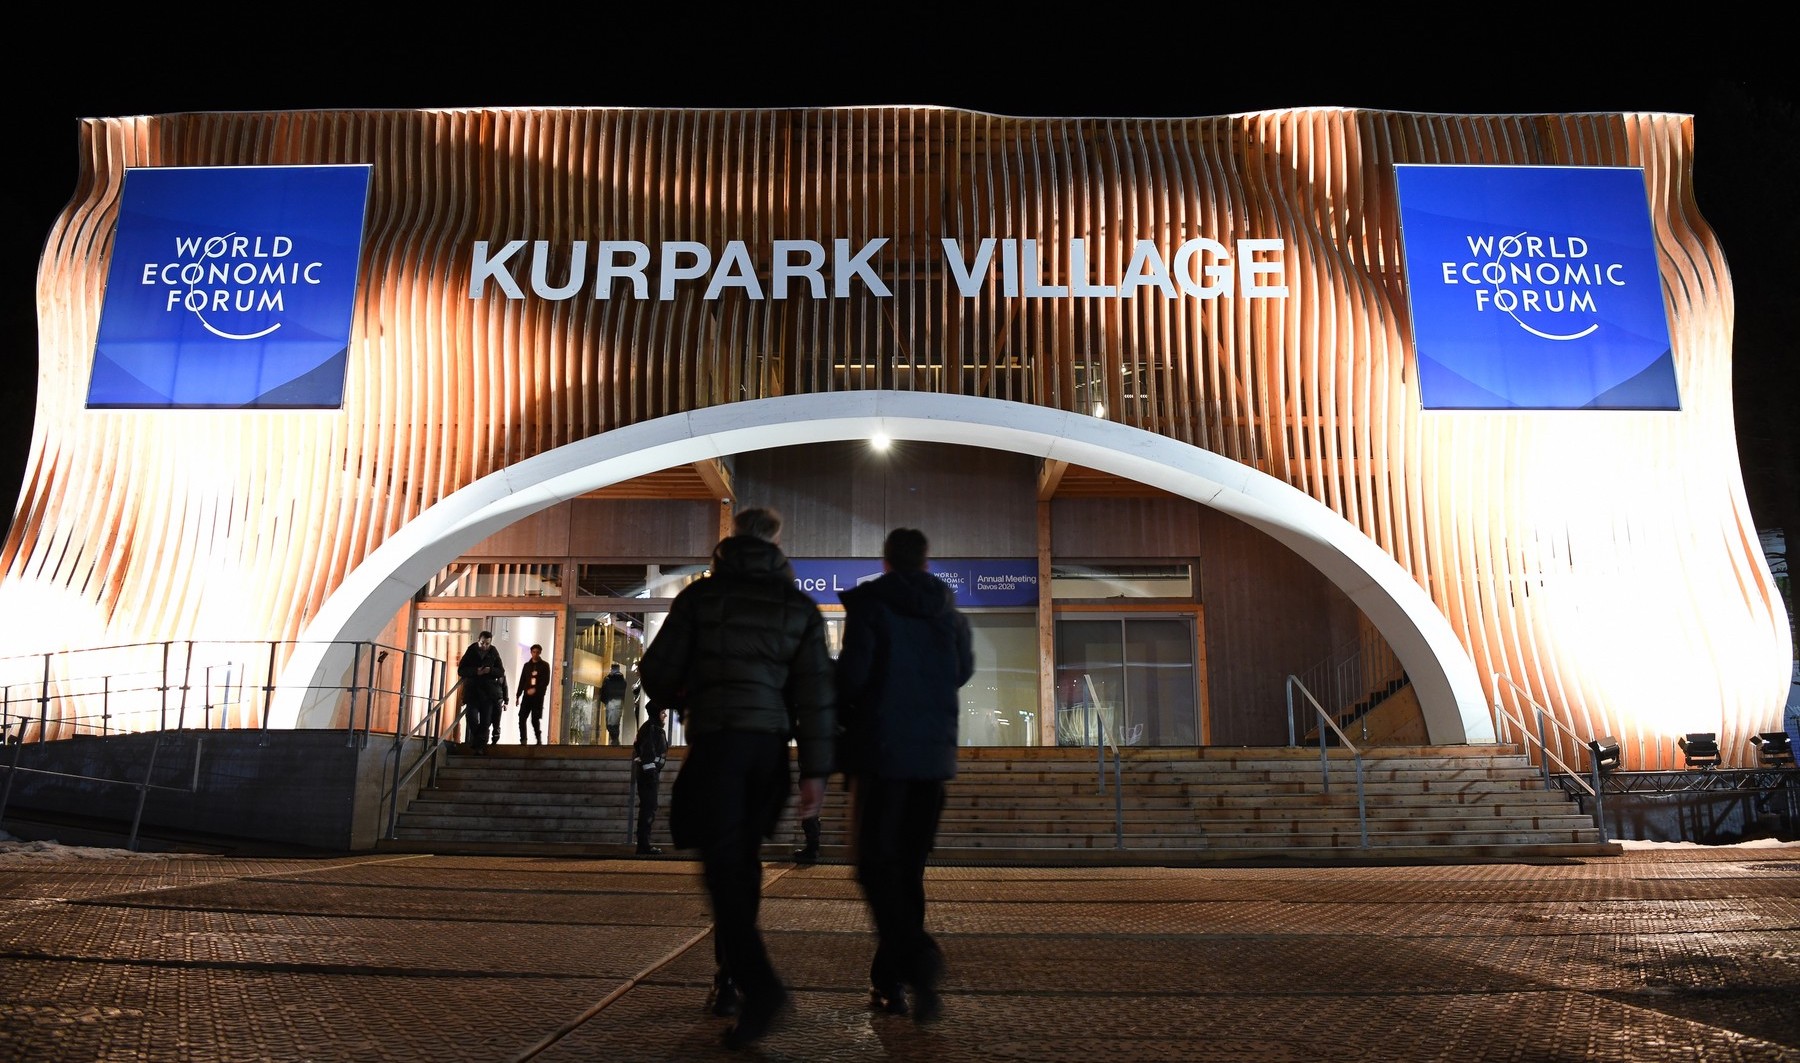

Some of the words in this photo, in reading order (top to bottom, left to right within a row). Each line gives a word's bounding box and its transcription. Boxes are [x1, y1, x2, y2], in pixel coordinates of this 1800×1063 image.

[175, 236, 293, 258] WORLD
[1466, 235, 1588, 259] WORLD
[141, 262, 323, 285] ECONOMIC
[468, 238, 893, 300] KURPARK
[941, 237, 1290, 300] VILLAGE
[1442, 262, 1626, 286] ECONOMIC
[166, 289, 285, 312] FORUM
[1475, 289, 1598, 313] FORUM
[793, 578, 827, 592] nce
[977, 574, 1005, 583] Annual
[1005, 574, 1037, 585] Meeting
